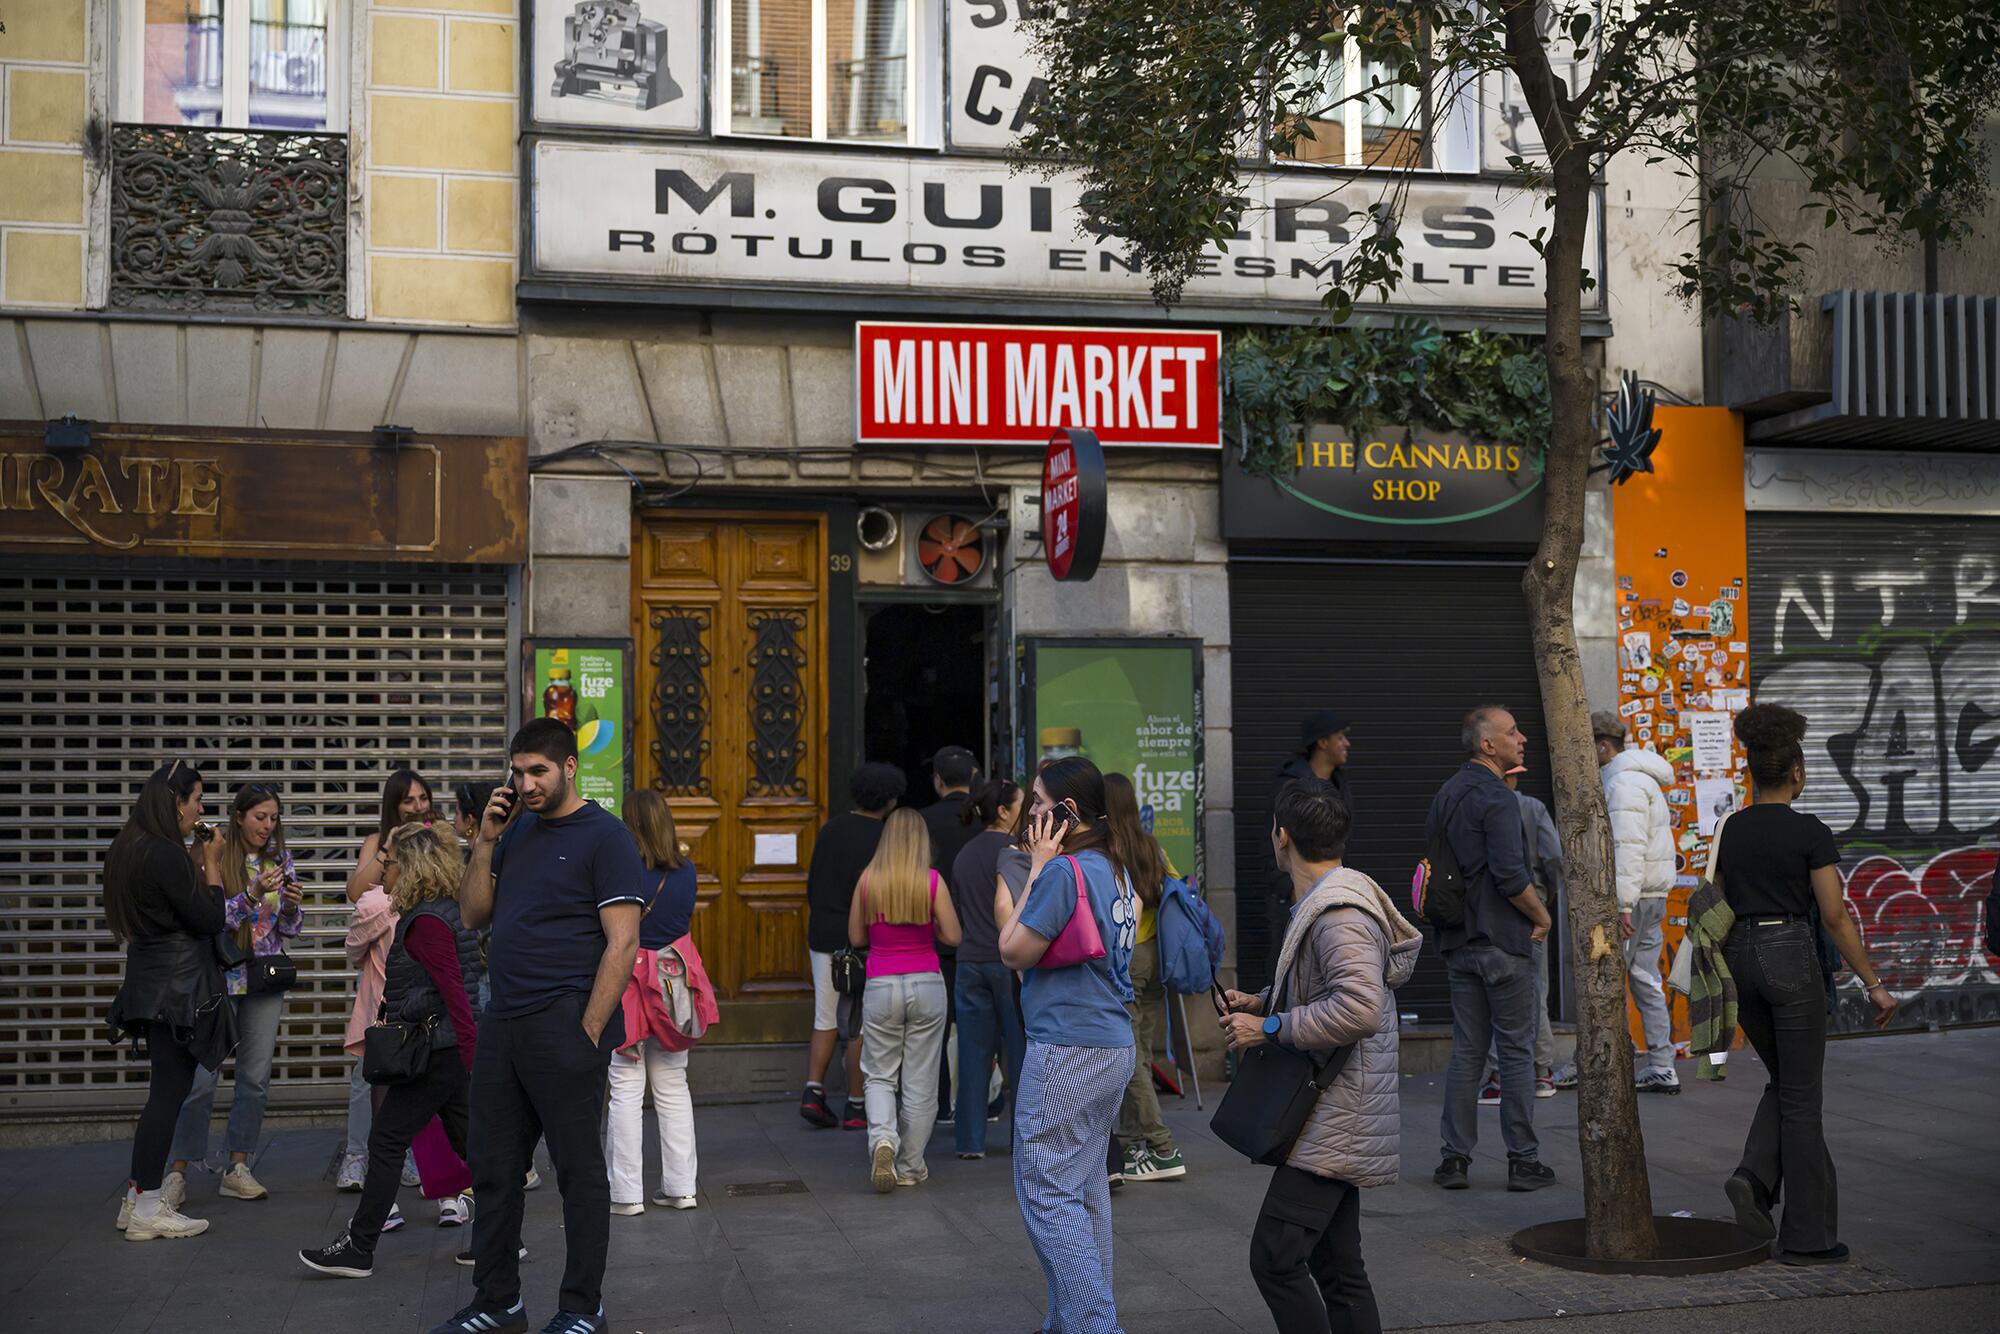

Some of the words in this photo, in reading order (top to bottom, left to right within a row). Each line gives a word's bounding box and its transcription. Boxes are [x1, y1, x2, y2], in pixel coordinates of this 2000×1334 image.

[655, 168, 777, 220] M.
[608, 225, 1007, 268] RÓTULOS
[1049, 248, 1142, 273] EN
[1190, 255, 1536, 287] ESMLTE
[874, 339, 989, 426] MINI
[1004, 342, 1206, 430] MARKET
[1050, 448, 1071, 480] MINI
[1364, 442, 1521, 472] CANNABIS
[1045, 476, 1078, 513] MARKET
[1372, 479, 1441, 502] SHOP
[1056, 510, 1068, 542] 24
[830, 554, 852, 572] 39
[580, 673, 614, 688] fuze
[580, 686, 606, 698] tea
[1136, 723, 1173, 736] sabor
[1176, 722, 1192, 735] de
[1137, 736, 1191, 750] siempre
[1132, 763, 1196, 791] fuze
[1135, 787, 1182, 812] tea
